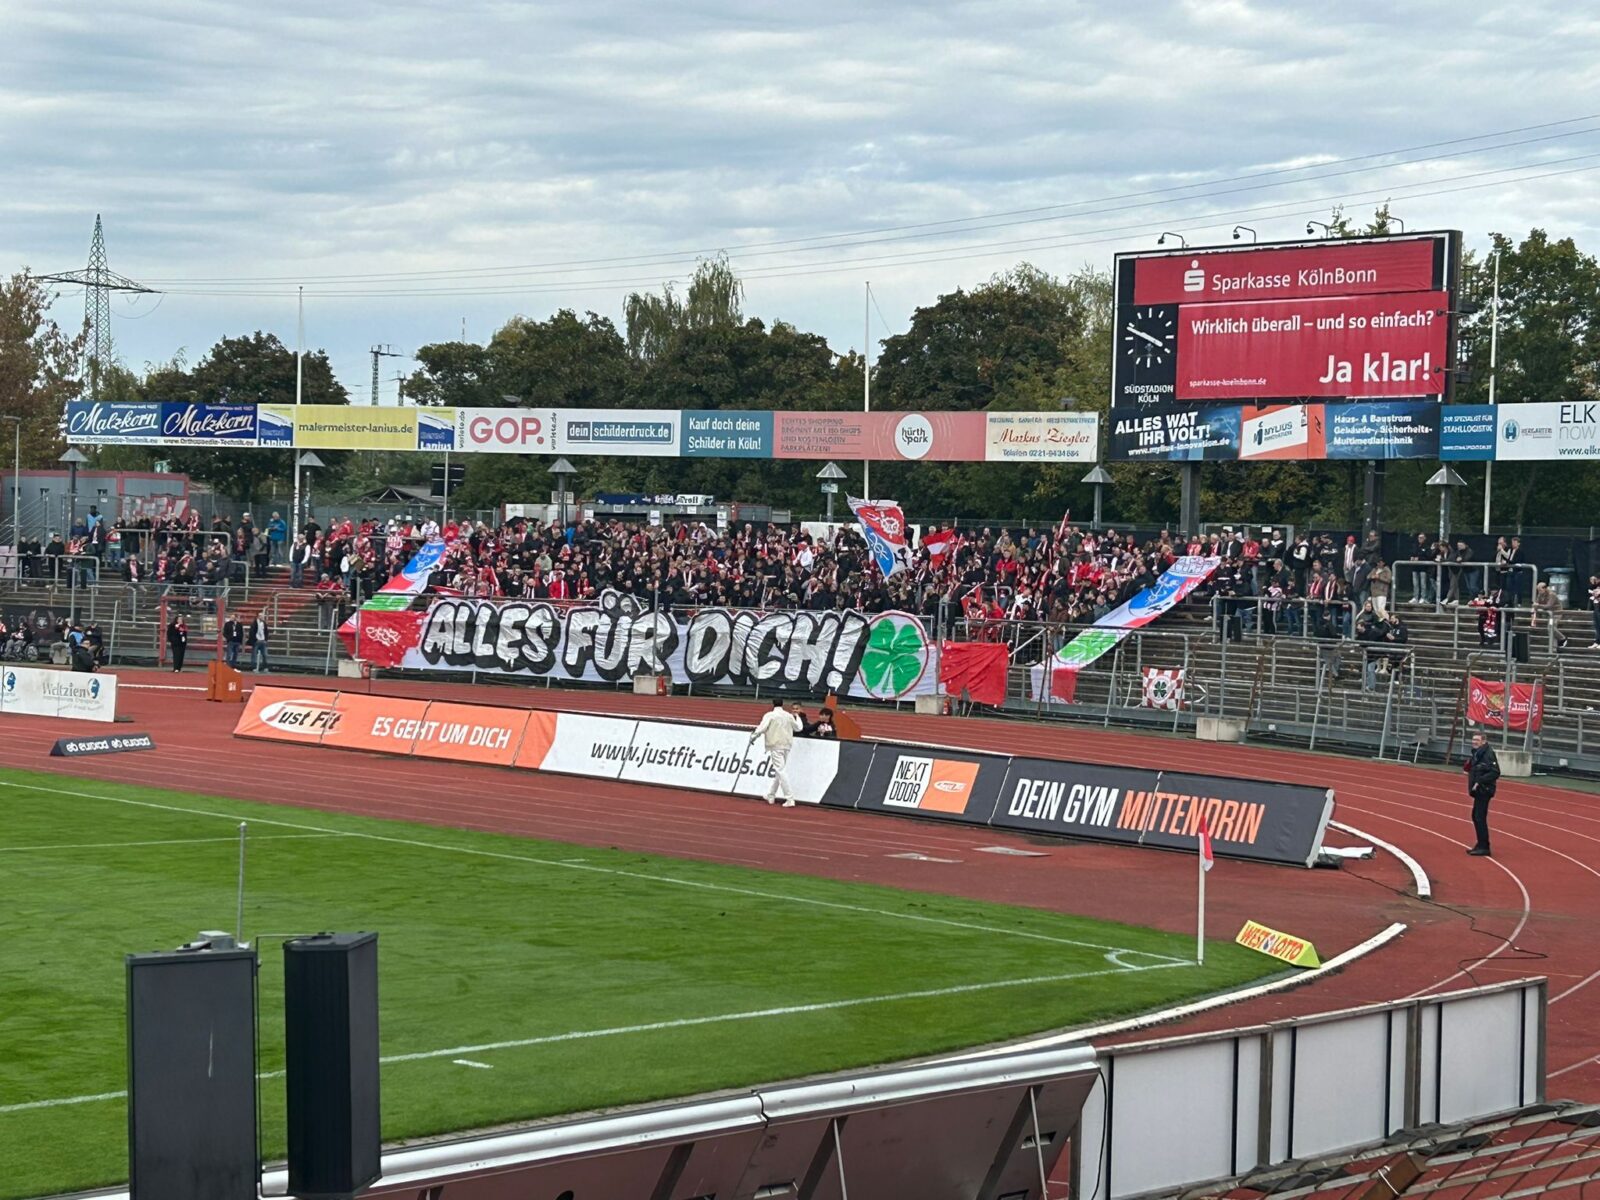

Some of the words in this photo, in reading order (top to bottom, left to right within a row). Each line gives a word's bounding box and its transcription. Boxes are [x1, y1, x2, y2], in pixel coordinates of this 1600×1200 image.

[1211, 271, 1290, 294] Sparkasse
[1297, 266, 1376, 286] KölnBonn
[1191, 317, 1248, 335] Wirklich
[1252, 315, 1301, 333] überall
[1316, 312, 1344, 330] und
[1348, 315, 1366, 329] so
[1370, 310, 1434, 328] einfach?
[1319, 354, 1352, 383] Ja
[1363, 351, 1431, 382] klar!
[1124, 384, 1174, 394] SÜDSTADION
[1138, 392, 1159, 403] KÖLN
[70, 402, 158, 434] Malzkorn
[163, 404, 254, 436] Malzkorn
[689, 417, 710, 431] Kauf
[712, 418, 733, 431] doch
[736, 418, 760, 431] deine
[1114, 416, 1162, 434] ALLES
[1166, 411, 1198, 428] WAT
[1334, 414, 1359, 423] Haus-
[1370, 414, 1412, 423] Baustrom
[1560, 404, 1596, 424] ELK
[299, 422, 413, 433] malermeister-lanius.de
[469, 416, 544, 445] GOP.
[569, 425, 588, 437] dein
[593, 425, 669, 438] schilderdruck.de
[902, 427, 925, 437] hürth
[994, 428, 1041, 444] Markus
[1045, 428, 1091, 446] Ziegler
[1139, 430, 1164, 446] IHR
[1168, 424, 1211, 442] VOLT!
[1264, 421, 1293, 436] MYLIUS
[1379, 425, 1433, 434] Sicherheits-
[1559, 426, 1596, 440] now
[688, 436, 725, 450] Schilder
[727, 437, 736, 449] in
[738, 436, 761, 450] Köln!
[906, 436, 928, 445] park
[1333, 436, 1413, 445] Multimediatechnik
[421, 601, 561, 674] ALLES
[562, 590, 679, 681] FÜR
[684, 608, 870, 694] DICH!
[265, 706, 313, 726] Just
[310, 710, 342, 730] Fit
[371, 716, 391, 736] ES
[393, 718, 438, 741] GEHT
[439, 723, 468, 745] UM
[469, 726, 512, 749] DICH
[896, 760, 929, 782] NEXT
[888, 781, 921, 803] DOOR
[1008, 778, 1065, 821] DEIN
[1062, 783, 1119, 828] GYM
[1116, 789, 1265, 844] MITTENDRIN
